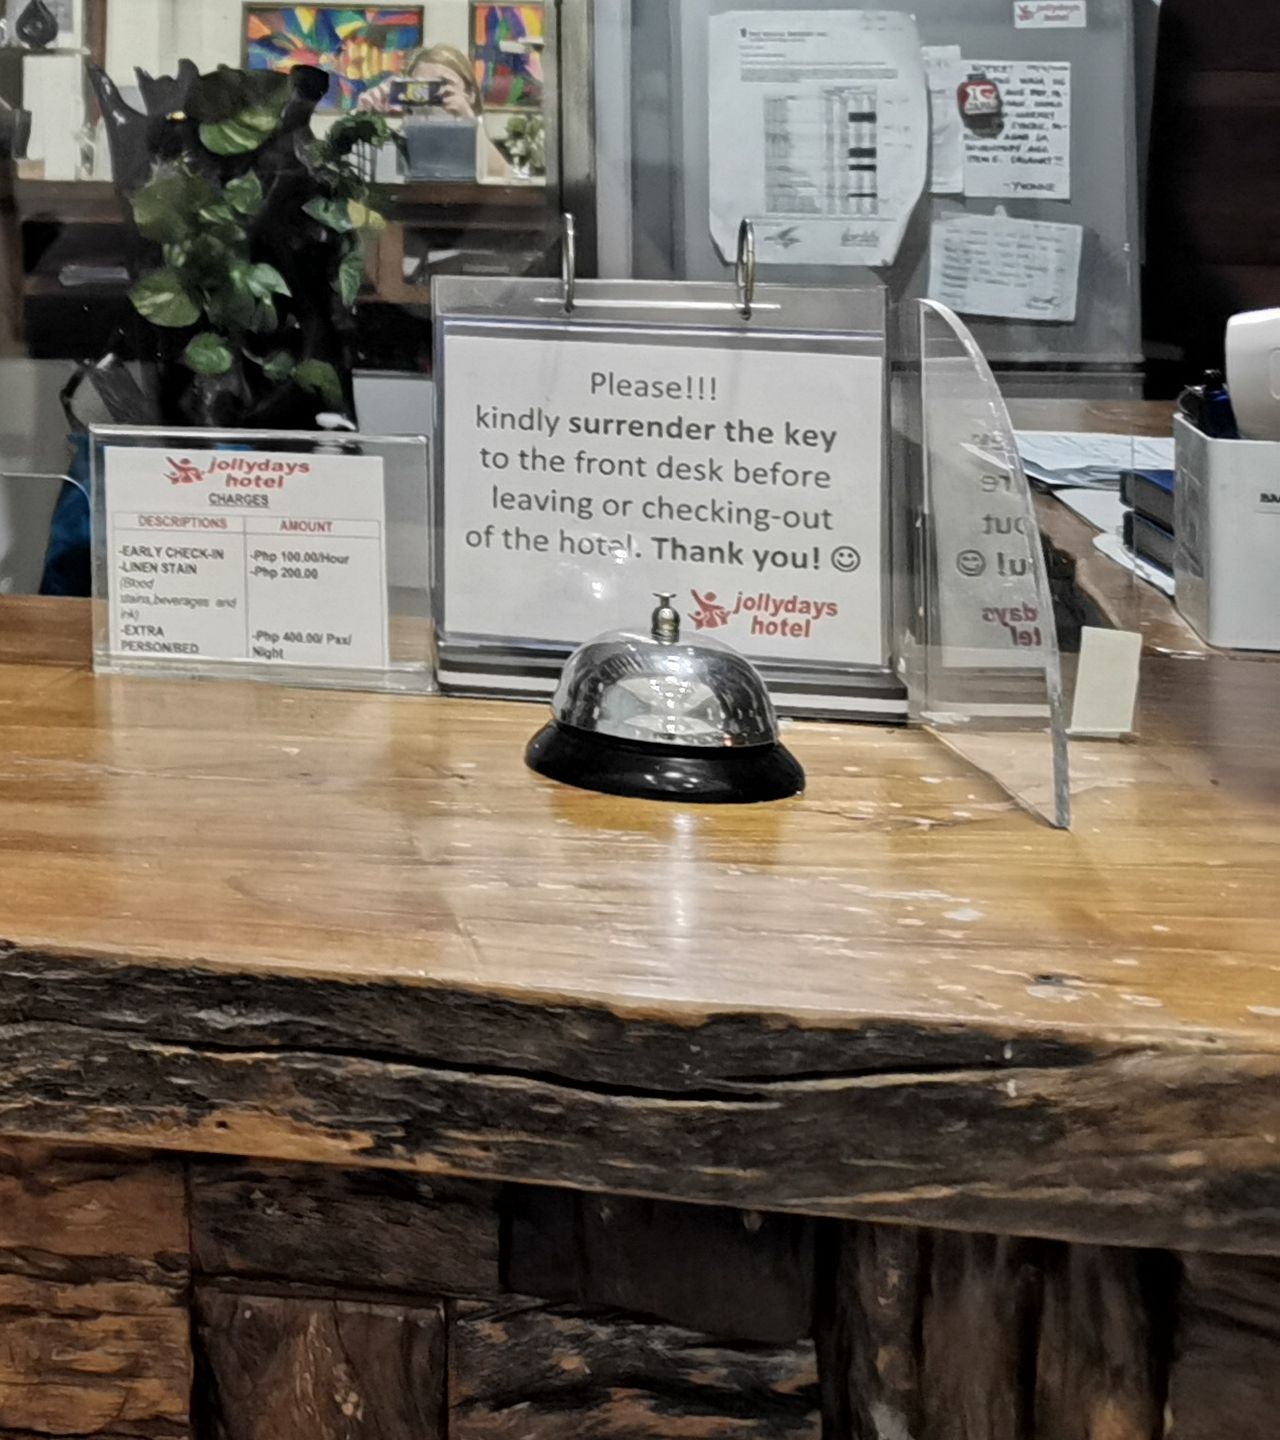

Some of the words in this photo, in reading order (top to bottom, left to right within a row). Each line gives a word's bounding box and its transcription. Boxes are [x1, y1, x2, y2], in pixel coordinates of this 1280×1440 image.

[590, 372, 718, 402] Please!!!
[475, 405, 561, 438] kindly
[568, 414, 716, 443] surrender
[724, 419, 775, 445] the
[784, 422, 838, 453] key
[208, 457, 310, 476] jollydays
[479, 447, 509, 470] to
[519, 448, 566, 474] the
[576, 450, 647, 479] front
[656, 456, 724, 483] desk
[734, 461, 832, 489] before
[225, 473, 284, 490] hotel
[208, 492, 270, 508] CHARGES
[492, 485, 594, 520] leaving
[602, 496, 634, 518] or
[642, 495, 834, 532] checking-out
[138, 515, 228, 530] DESCRIPTIONS
[280, 520, 334, 534] AMOUNT
[165, 546, 225, 561] CHECK-IN
[465, 526, 497, 550] of
[502, 527, 550, 553] the
[651, 536, 745, 566] Thank
[752, 545, 822, 574] you!
[161, 563, 198, 576] STAIN
[732, 590, 838, 618] jollydays
[750, 614, 812, 639] hotel
